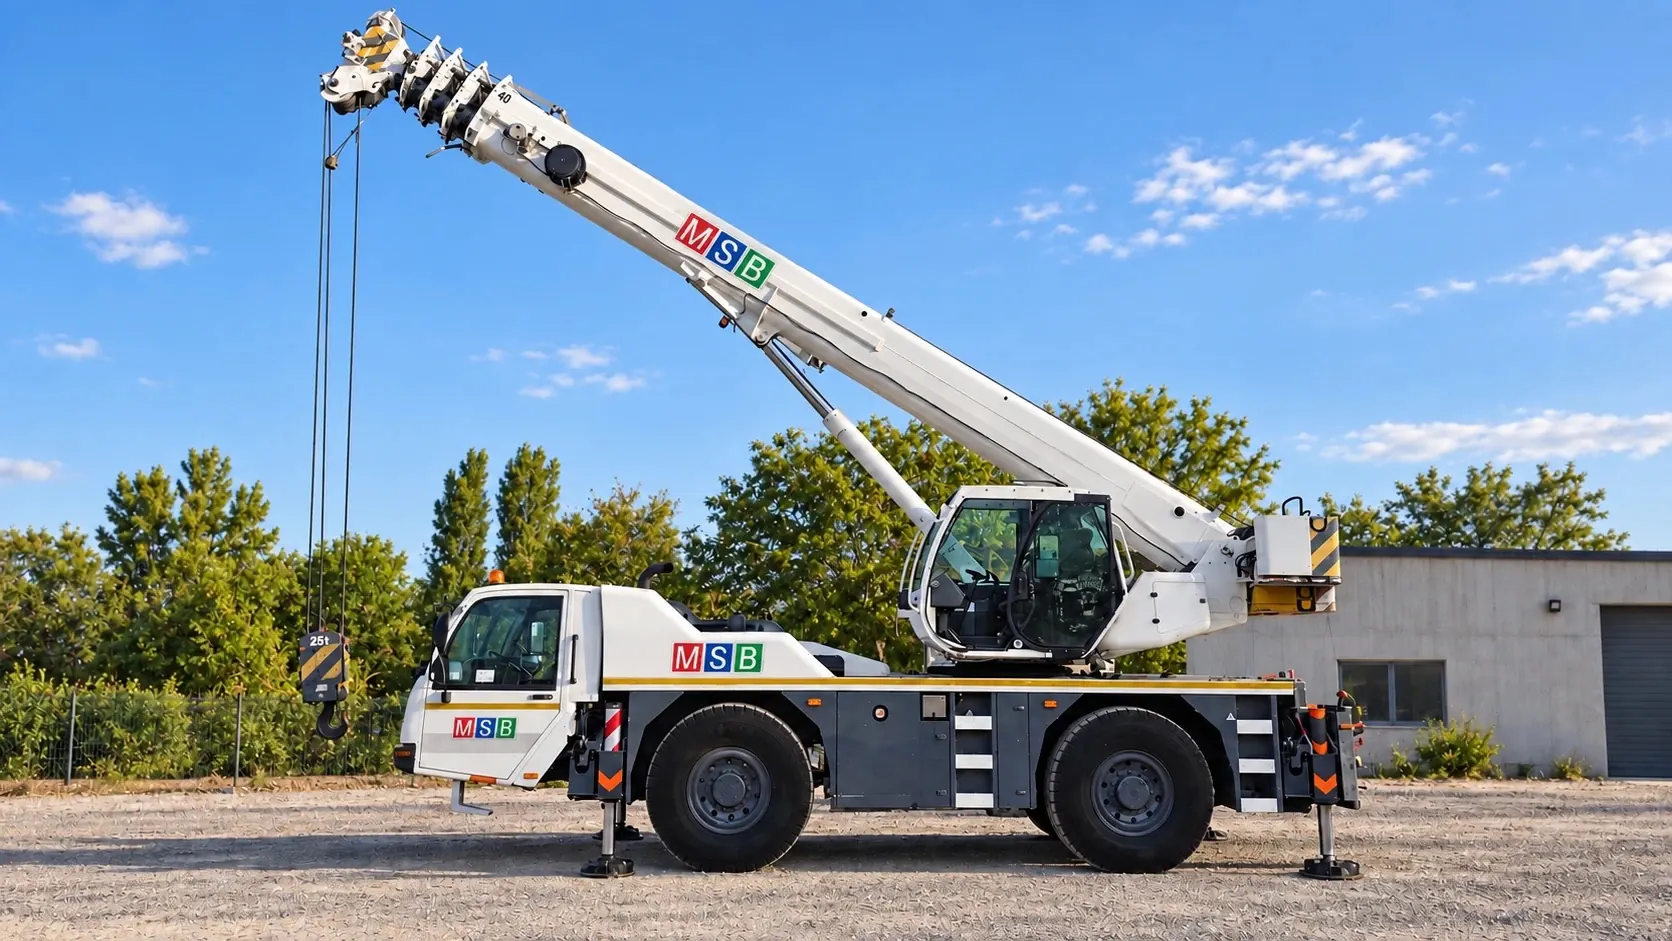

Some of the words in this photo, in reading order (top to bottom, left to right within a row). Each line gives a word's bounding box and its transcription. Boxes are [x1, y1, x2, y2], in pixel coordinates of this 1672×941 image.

[498, 92, 511, 103] 40
[680, 218, 767, 281] MSB
[310, 636, 329, 646] 25t
[675, 646, 757, 670] MSB
[455, 719, 513, 737] MSB
